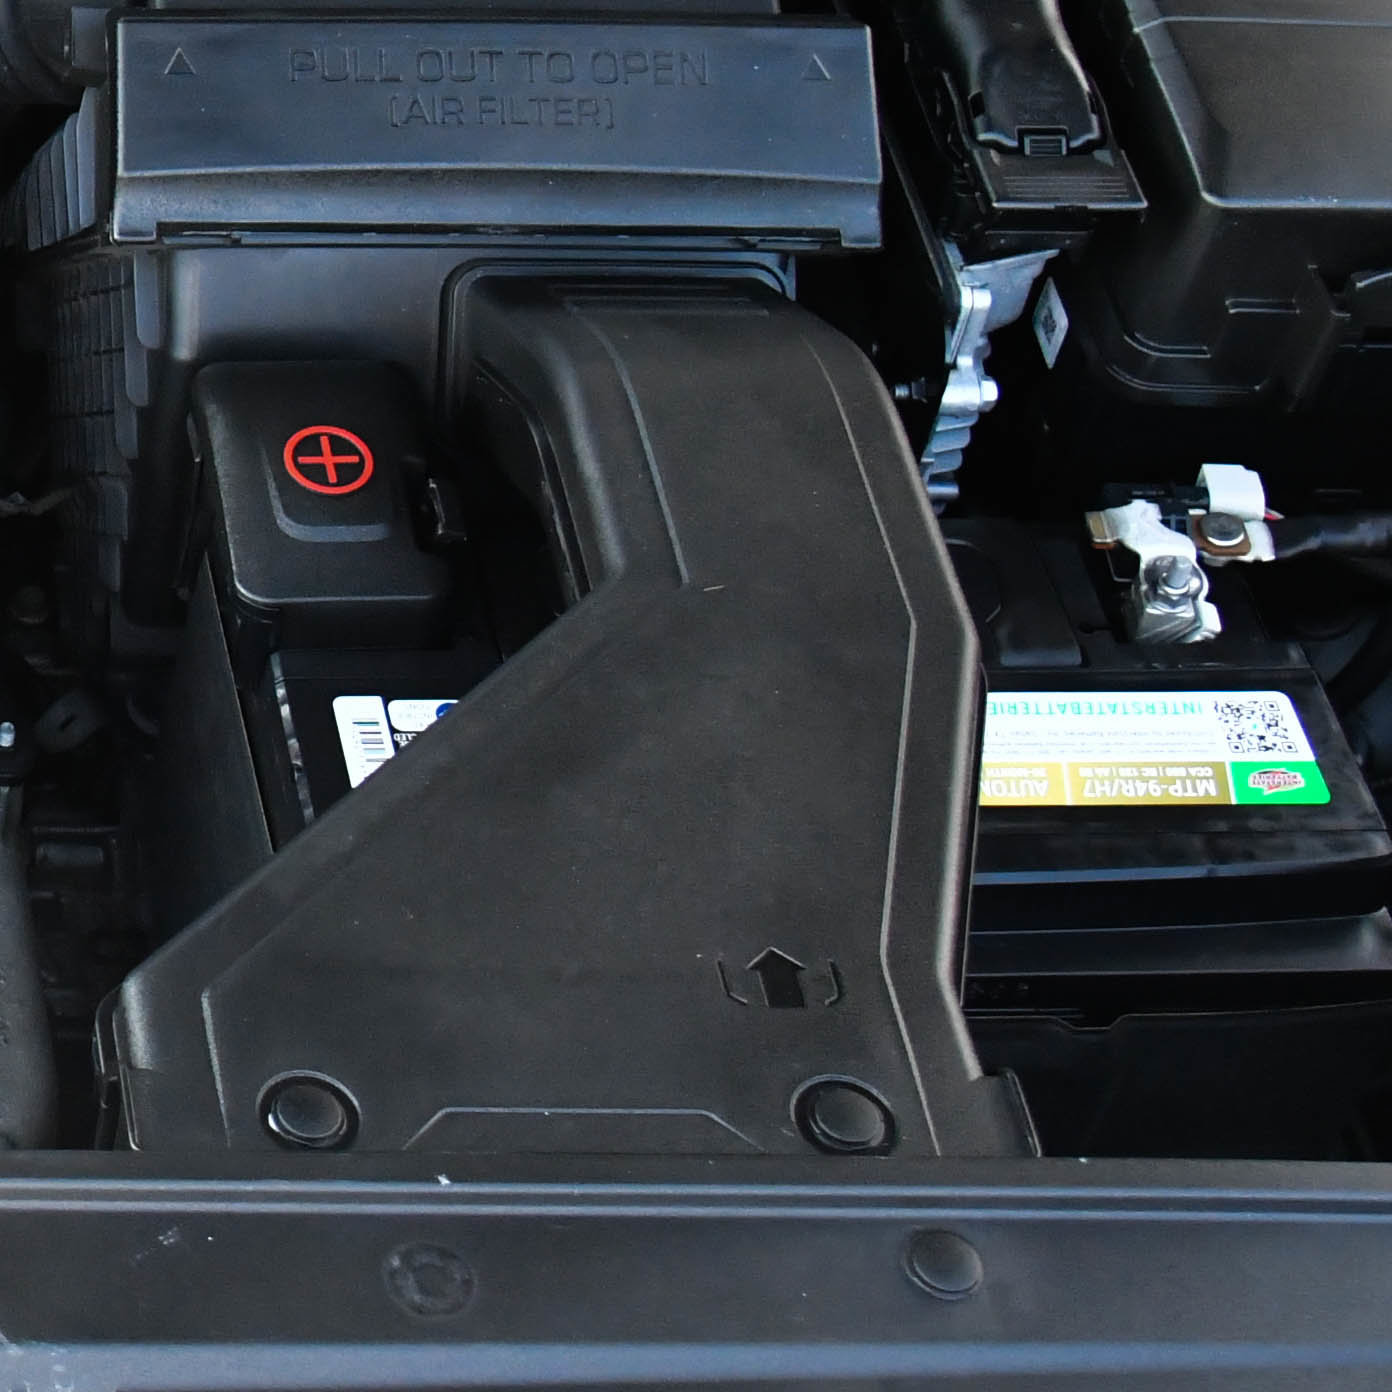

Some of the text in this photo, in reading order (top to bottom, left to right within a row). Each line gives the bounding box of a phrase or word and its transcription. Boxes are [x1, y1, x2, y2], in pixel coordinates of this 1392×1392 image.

[288, 48, 710, 87] PULL OUT TO OPEN
[1083, 778, 1218, 799] MTP-94R/H7
